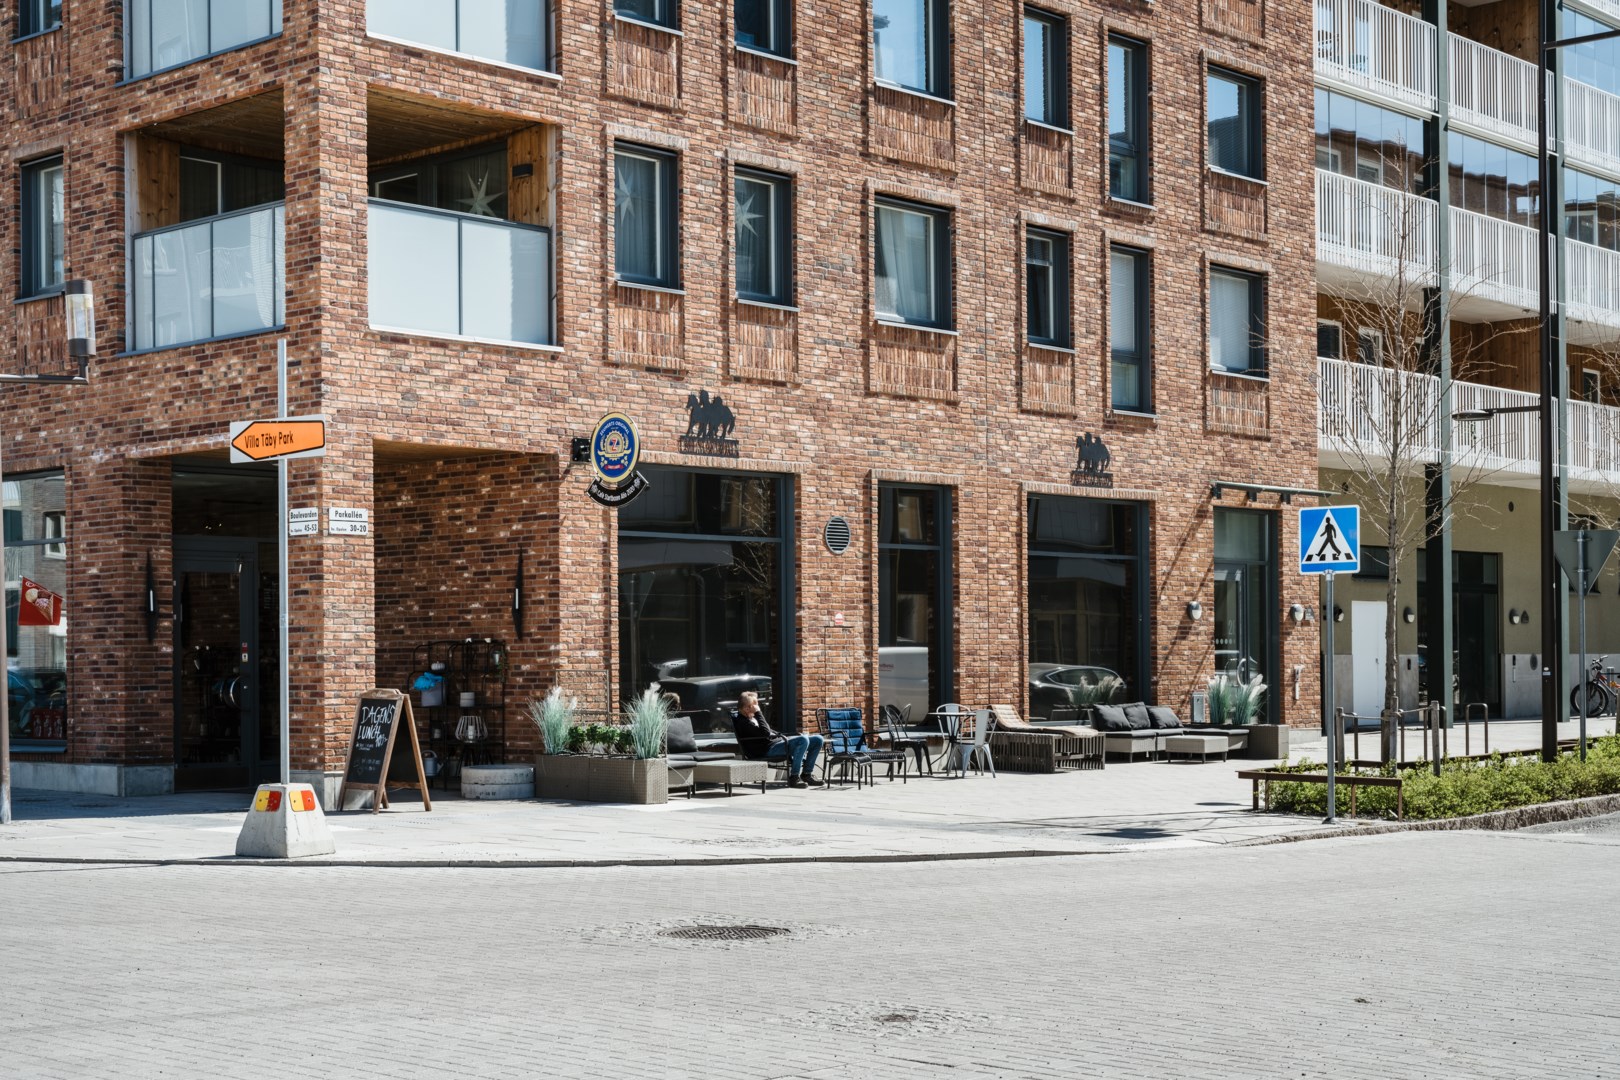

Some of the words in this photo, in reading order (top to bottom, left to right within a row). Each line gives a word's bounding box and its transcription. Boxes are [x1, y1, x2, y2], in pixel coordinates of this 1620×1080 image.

[244, 435, 260, 448] Villa
[261, 432, 277, 449] Täby
[278, 431, 294, 445] Park
[290, 510, 317, 519] Boulevarden
[334, 510, 363, 519] Parkallén
[304, 524, 317, 532] 45-53
[349, 524, 367, 532] 30-20
[360, 704, 396, 724] DAGENS
[357, 722, 381, 740] LUNCH
